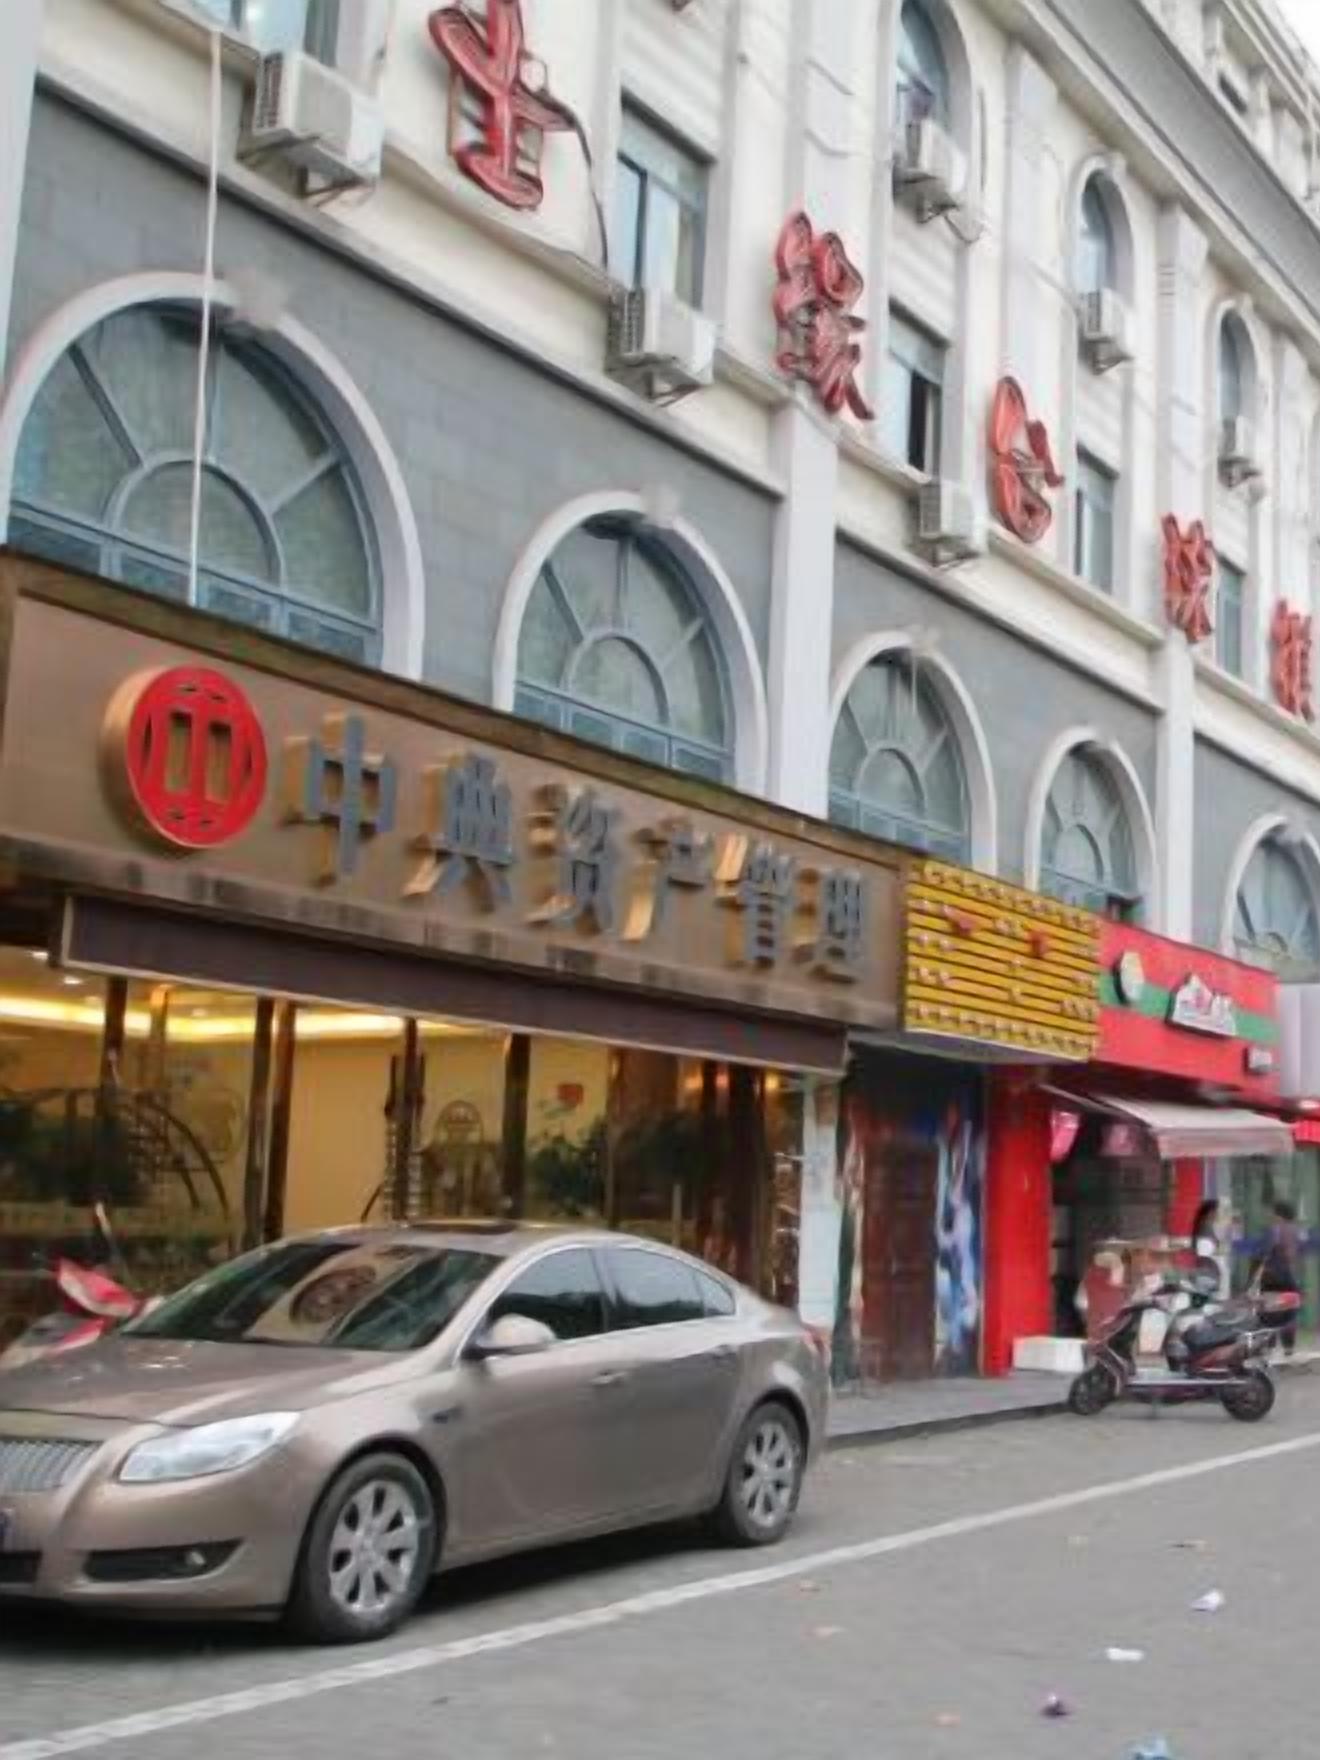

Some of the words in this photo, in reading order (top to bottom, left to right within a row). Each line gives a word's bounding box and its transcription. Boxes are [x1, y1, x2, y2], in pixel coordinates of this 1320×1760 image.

[284, 711, 865, 981] 中典资产管理
